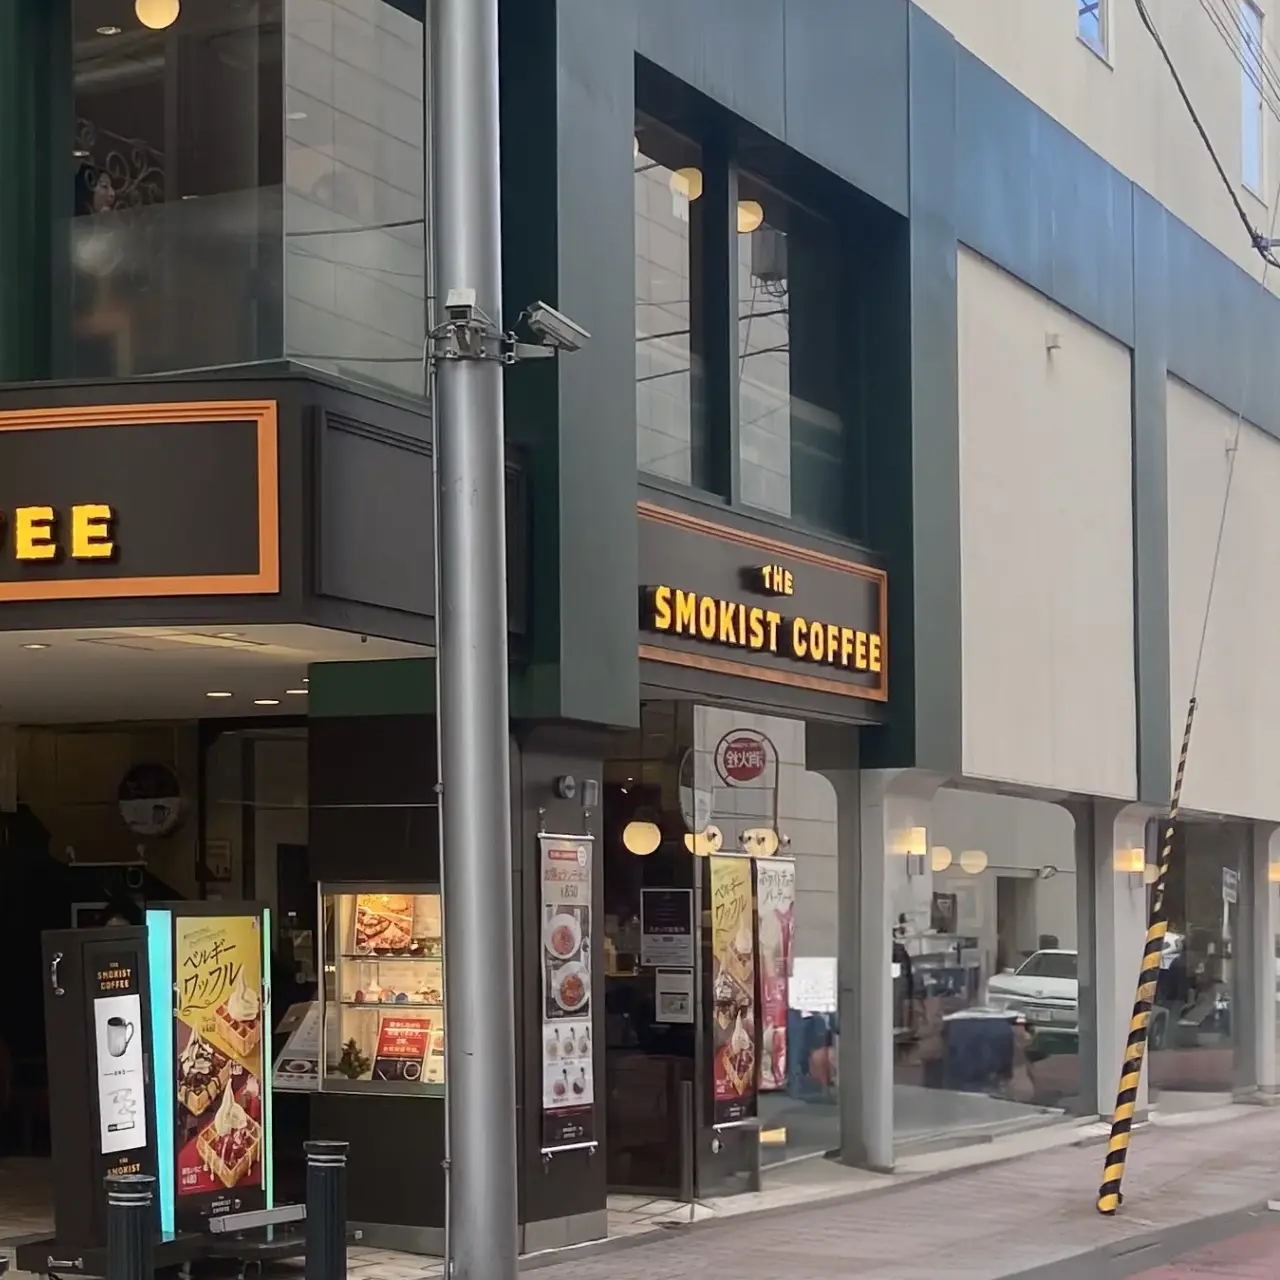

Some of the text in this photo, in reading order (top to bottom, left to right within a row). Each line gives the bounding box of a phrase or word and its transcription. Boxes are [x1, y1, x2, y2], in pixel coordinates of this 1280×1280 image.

[762, 565, 795, 595] THE
[655, 585, 882, 672] SMOKIST COFFEE
[183, 938, 237, 969] ベルギー
[97, 969, 132, 980] SMOKIST
[100, 980, 130, 990] COFFEE
[182, 961, 243, 1008] ワッフル
